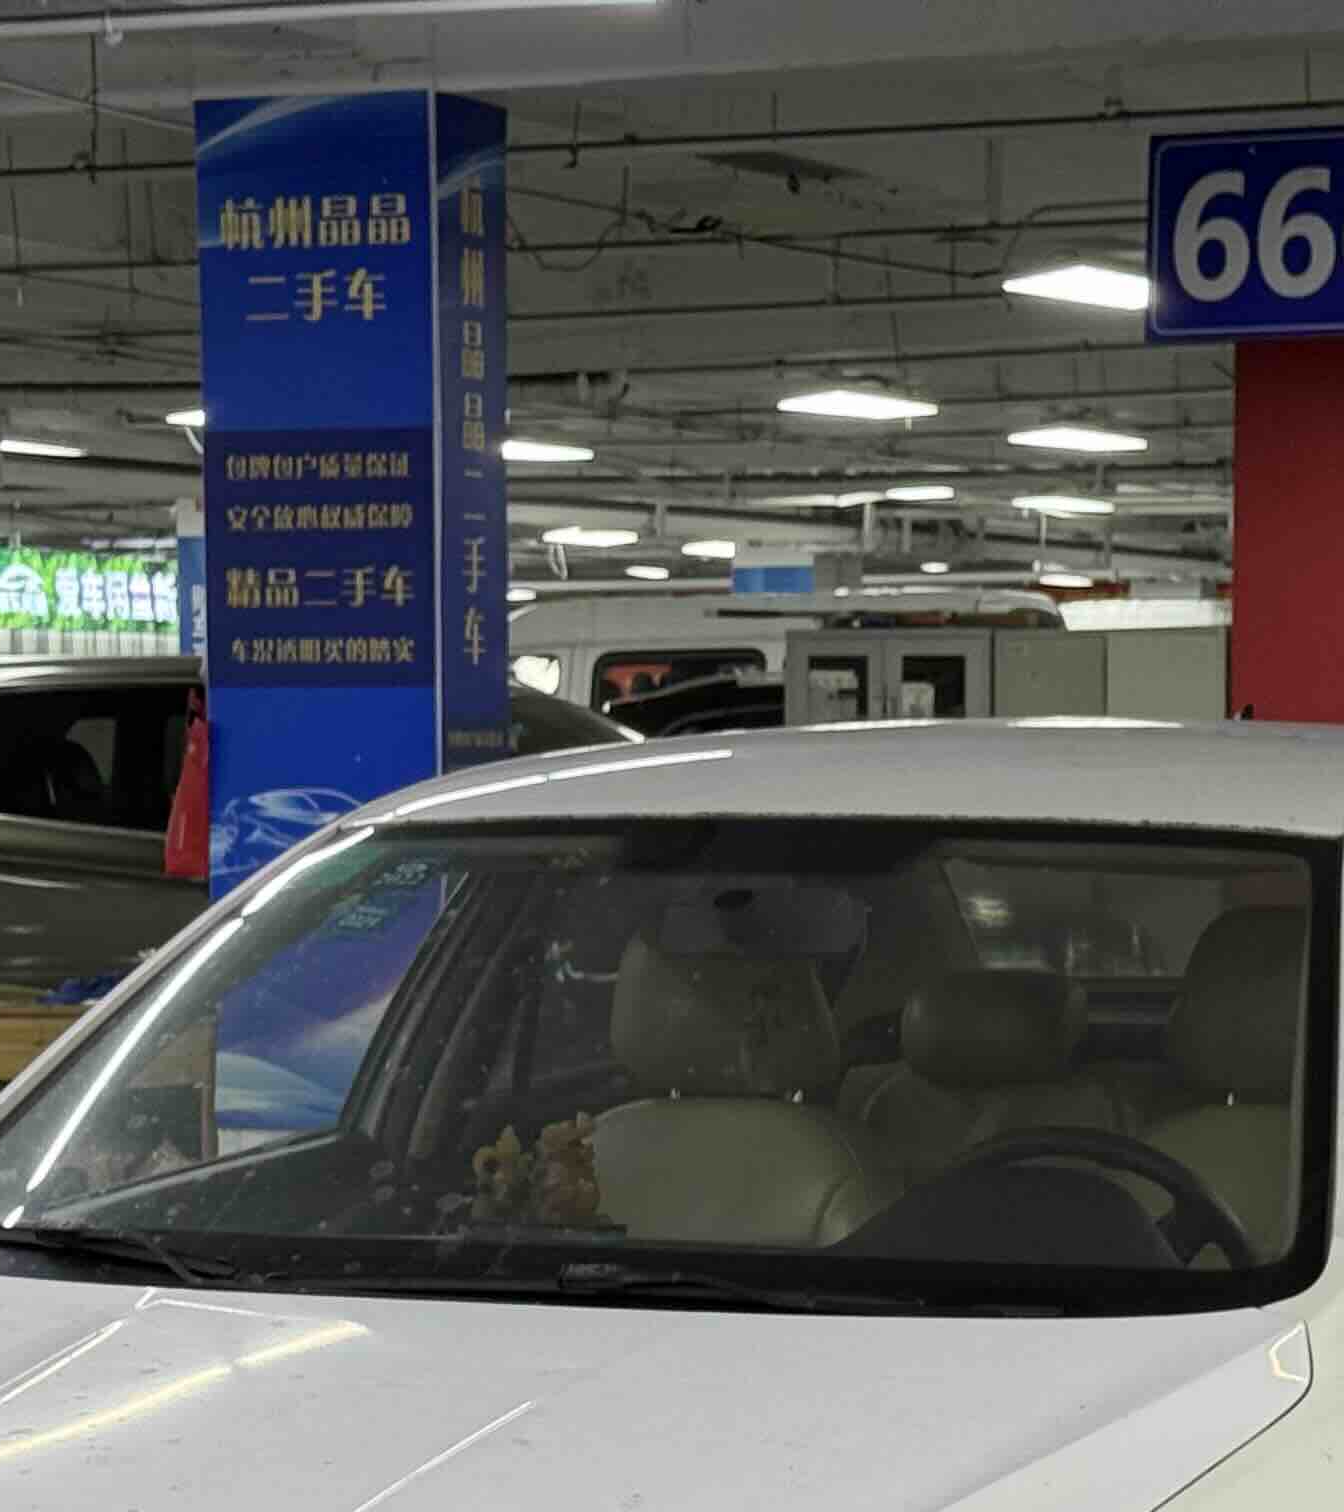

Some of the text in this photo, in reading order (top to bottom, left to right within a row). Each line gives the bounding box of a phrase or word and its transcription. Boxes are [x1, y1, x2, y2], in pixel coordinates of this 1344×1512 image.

[219, 192, 411, 250] 杭州晶晶
[245, 266, 388, 323] 二手车
[224, 564, 416, 608] 精品二手车
